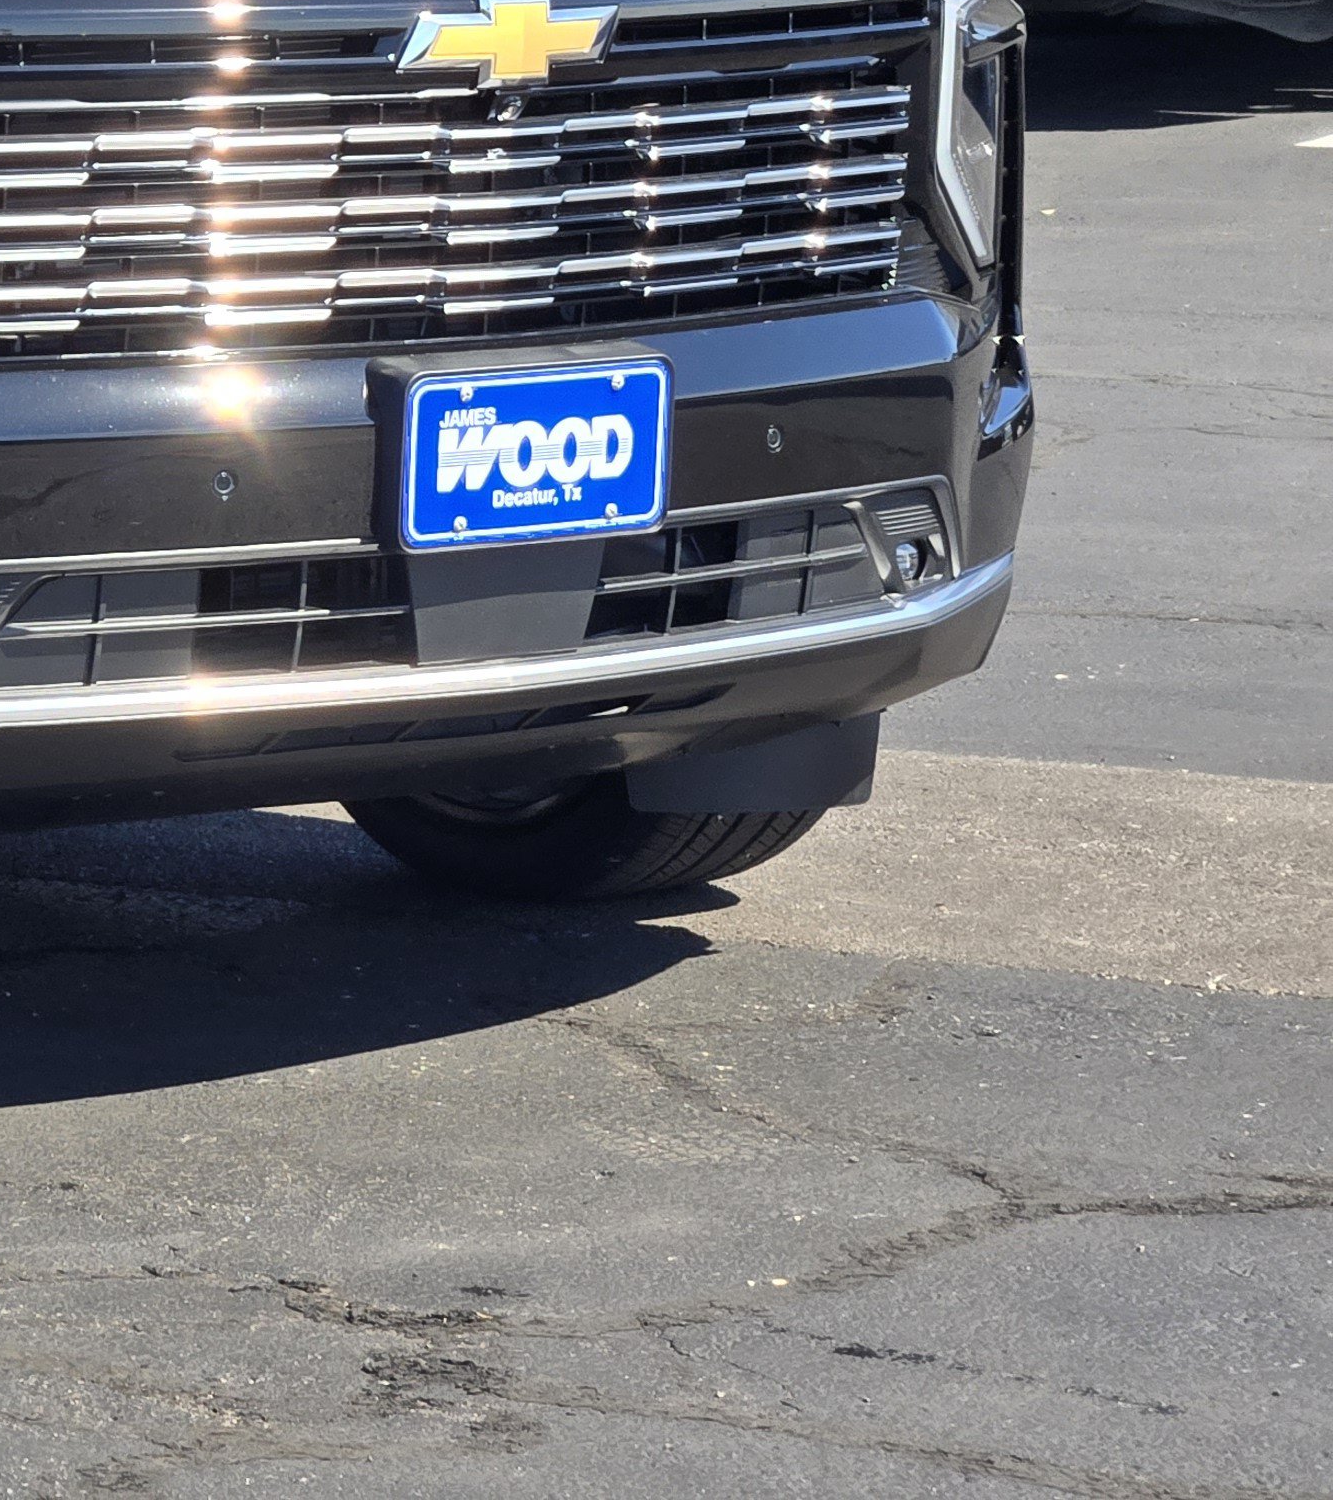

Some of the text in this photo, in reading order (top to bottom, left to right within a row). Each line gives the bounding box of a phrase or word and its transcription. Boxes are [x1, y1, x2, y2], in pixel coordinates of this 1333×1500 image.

[439, 406, 497, 429] JAMES
[436, 413, 634, 494] WOOD
[492, 486, 559, 509] Decatur,
